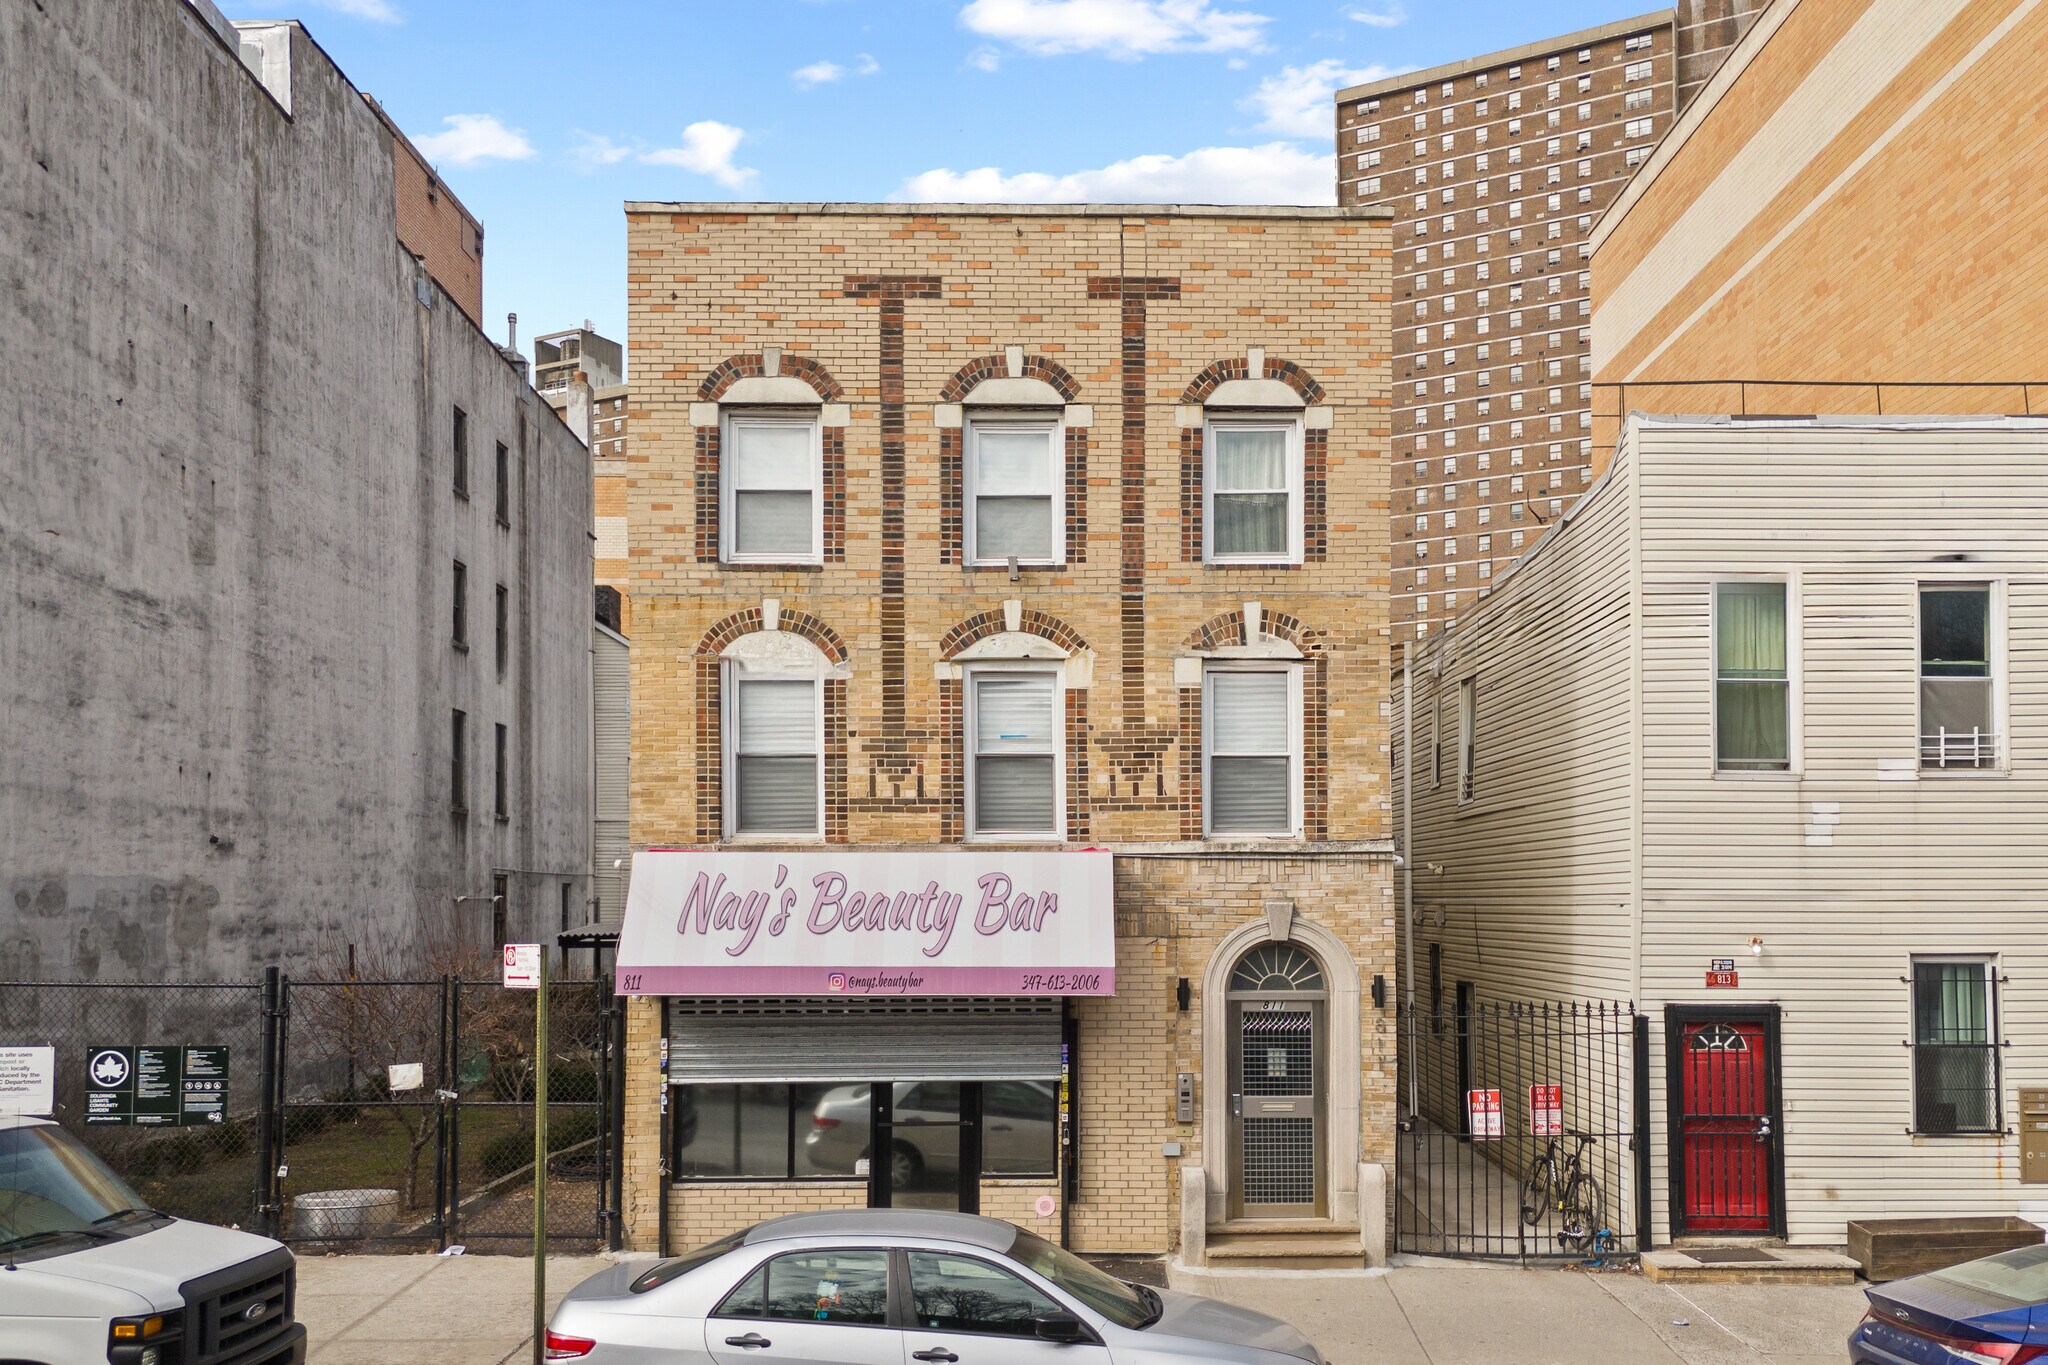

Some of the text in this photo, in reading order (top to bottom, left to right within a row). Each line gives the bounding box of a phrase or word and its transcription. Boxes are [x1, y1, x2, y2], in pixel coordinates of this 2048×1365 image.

[677, 864, 1058, 957] Nay's Beauty Bar
[623, 974, 643, 990] 811
[848, 971, 924, 993] @nays.beautybar
[1022, 974, 1100, 990] 347-613-2006
[1717, 974, 1731, 984] 813
[1262, 1001, 1284, 1010] 811
[1478, 1093, 1491, 1101] NO
